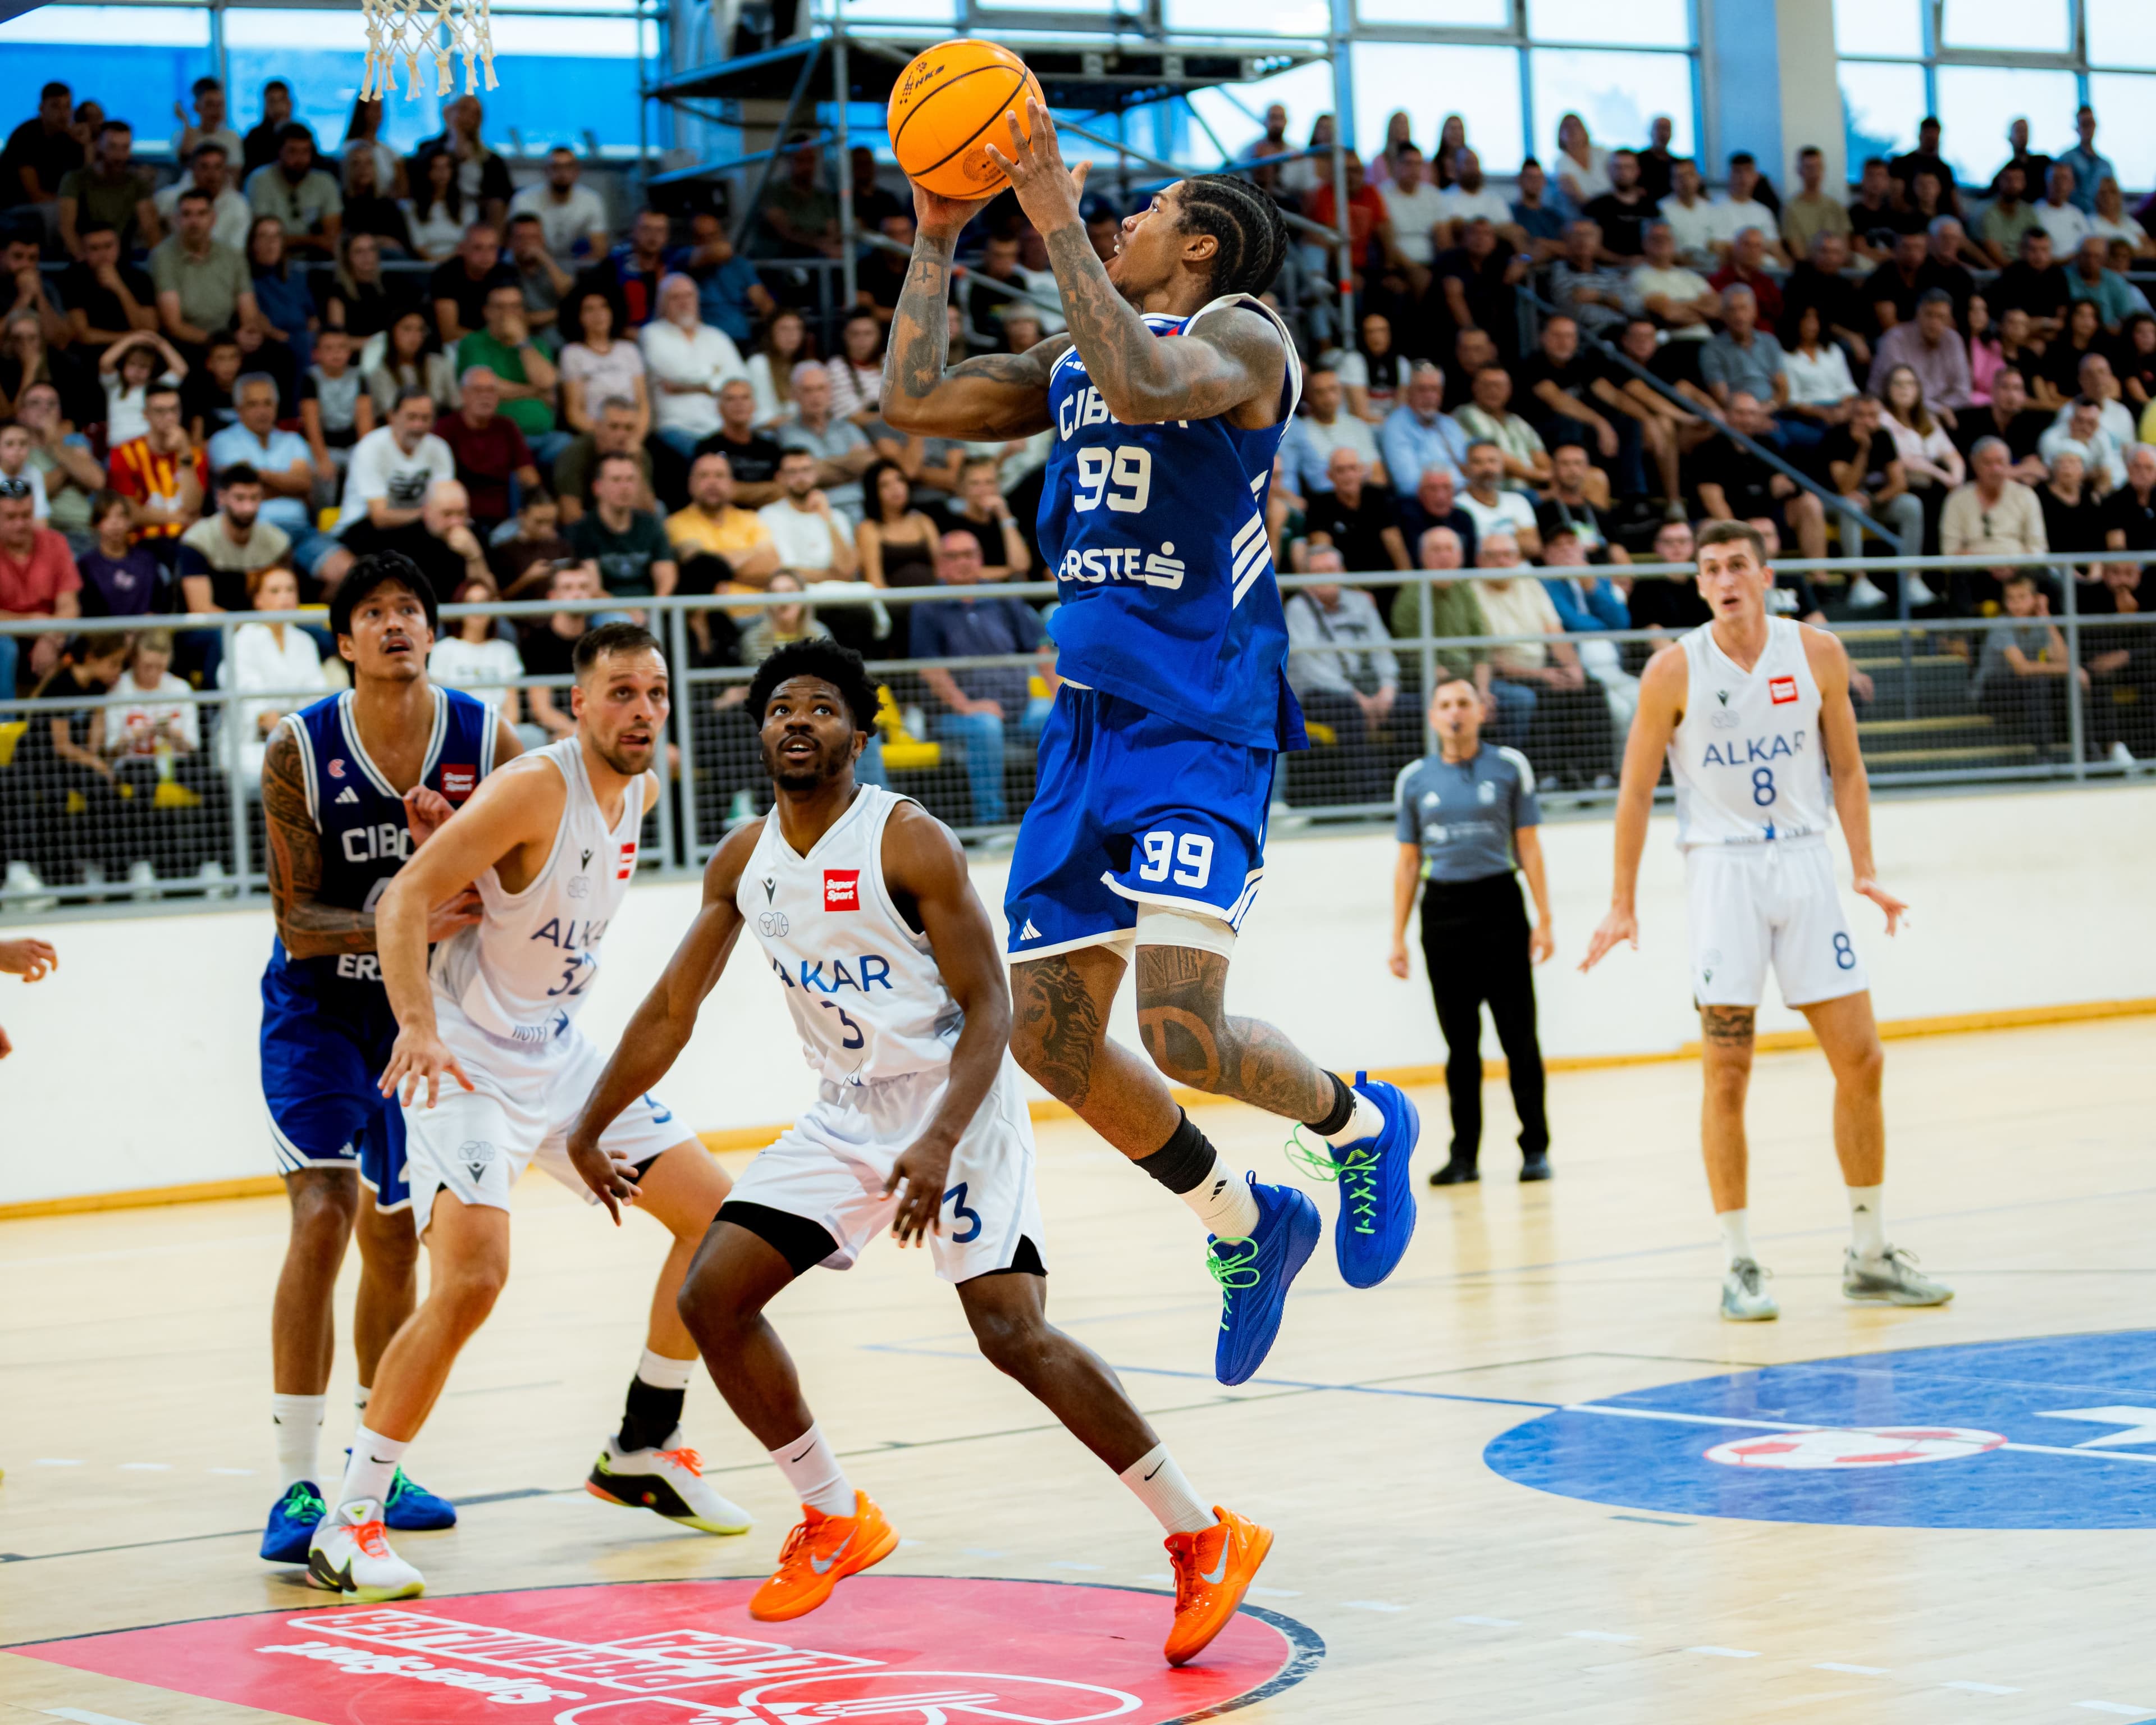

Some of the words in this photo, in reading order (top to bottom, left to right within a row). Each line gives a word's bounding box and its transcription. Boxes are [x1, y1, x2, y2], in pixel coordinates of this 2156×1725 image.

[1074, 446, 1151, 513] 99
[1058, 549, 1145, 583] ERSTE
[1702, 731, 1806, 767] ALKAR
[1752, 766, 1776, 806] 8
[1140, 831, 1214, 889] 99
[826, 879, 856, 891] Super
[827, 889, 854, 902] Sport
[1833, 932, 1855, 969] 8
[547, 953, 596, 996] 32
[773, 955, 893, 993] AKAR
[820, 1001, 865, 1049] 3
[943, 1181, 981, 1243] 3
[254, 1641, 587, 1704] SuperSport
